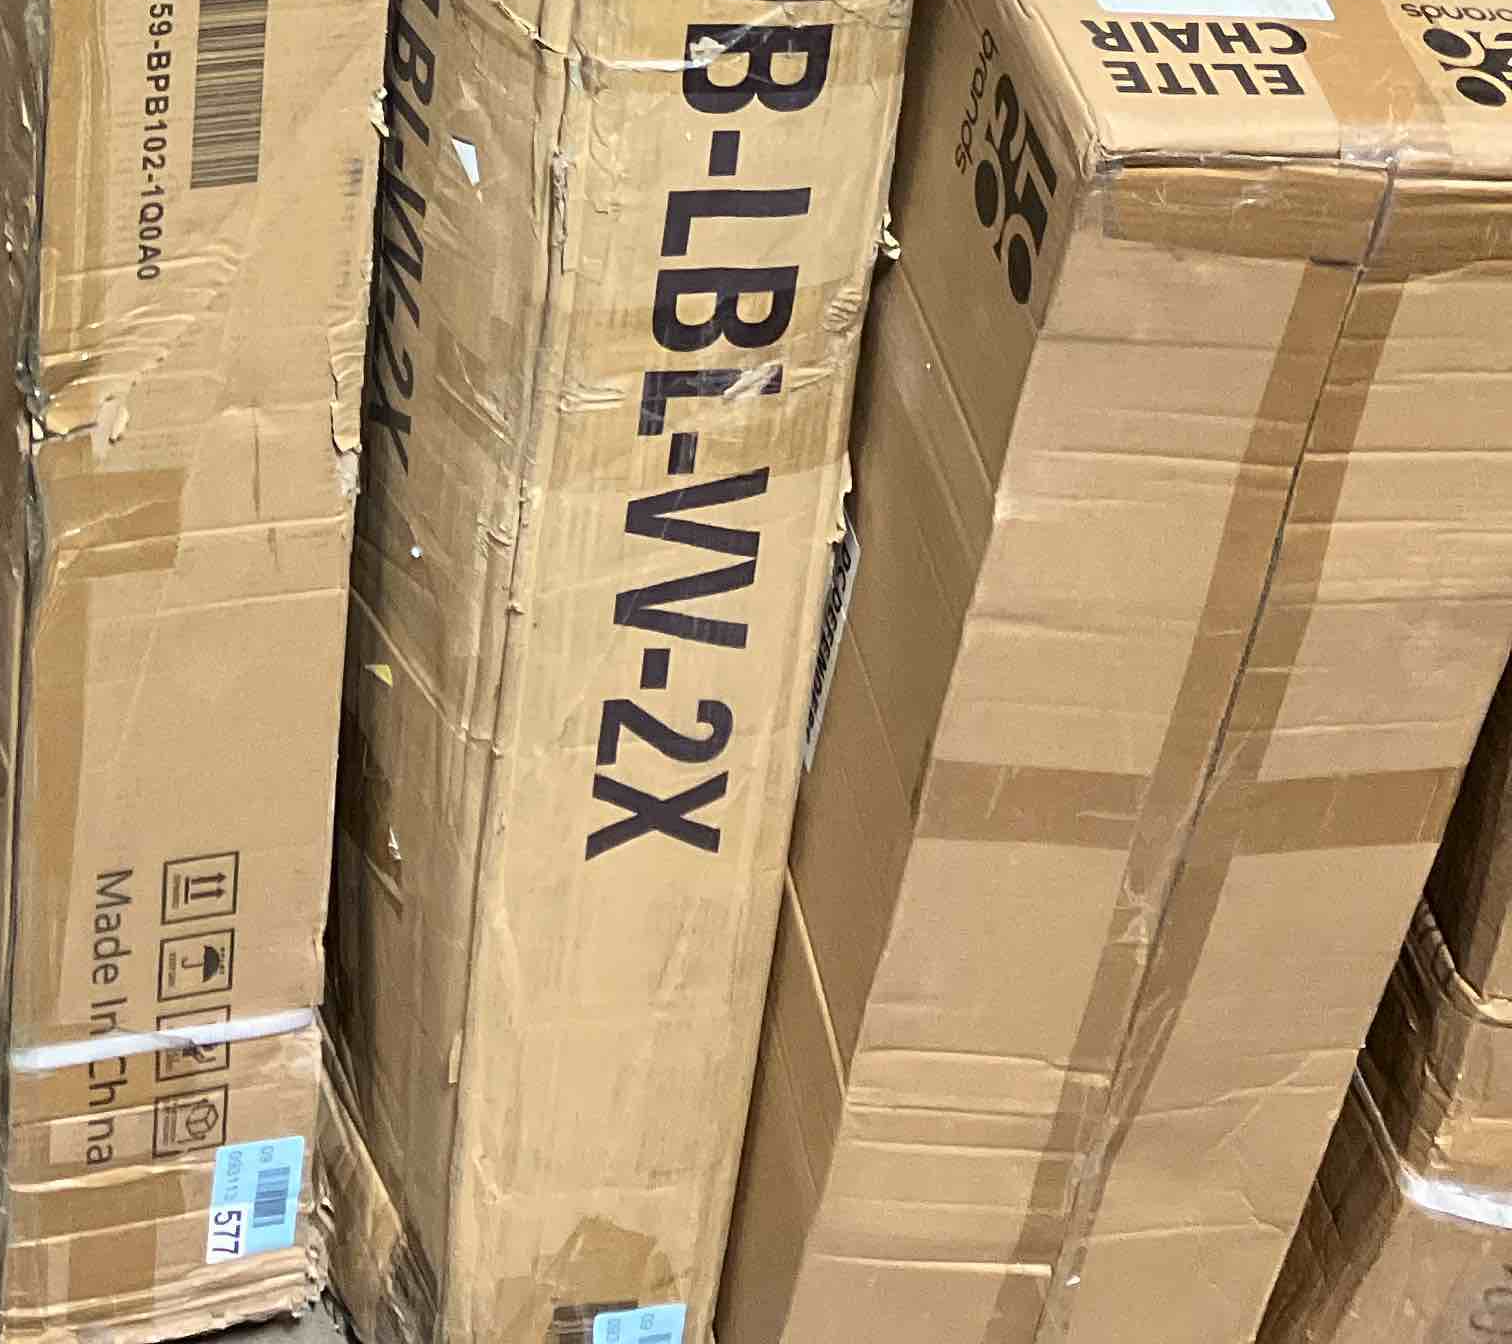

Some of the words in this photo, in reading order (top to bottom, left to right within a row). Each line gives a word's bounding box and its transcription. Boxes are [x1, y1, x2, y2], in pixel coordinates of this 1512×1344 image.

[1081, 19, 1307, 55] CHAIR
[954, 26, 1000, 174] brands
[1113, 60, 1306, 97] ELITE
[91, 867, 134, 985] Made
[211, 1208, 243, 1256] 577
